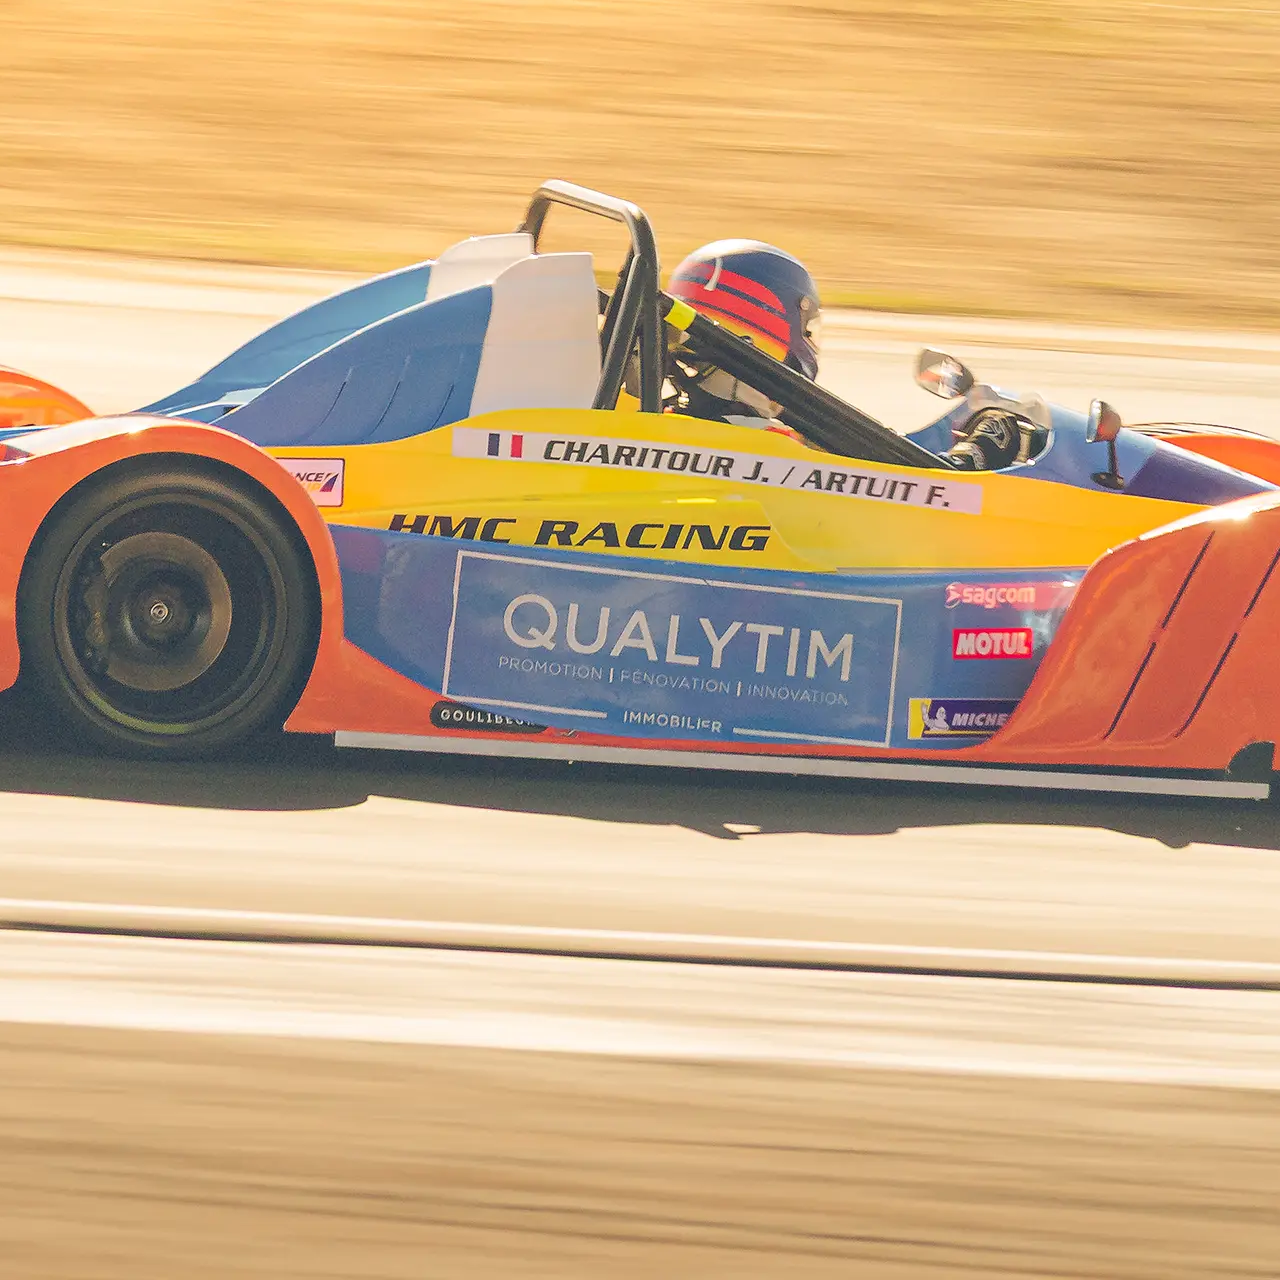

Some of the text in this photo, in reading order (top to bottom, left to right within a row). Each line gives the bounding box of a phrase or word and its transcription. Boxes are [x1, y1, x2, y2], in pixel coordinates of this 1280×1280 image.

[295, 472, 325, 482] NCE
[543, 439, 735, 478] CHARITOUR
[742, 461, 769, 483] J.
[800, 469, 918, 502] ARTUIT
[924, 485, 950, 507] F.
[388, 514, 771, 551] HMC RACING
[962, 587, 1036, 609] sagcom
[503, 593, 854, 682] QUALYTIM
[955, 632, 1028, 656] MOTUL
[498, 655, 603, 680] PROMOTION
[747, 683, 850, 706] INNOVATION
[623, 710, 723, 734] IMMOBILIER
[951, 712, 1010, 727] MICHE
